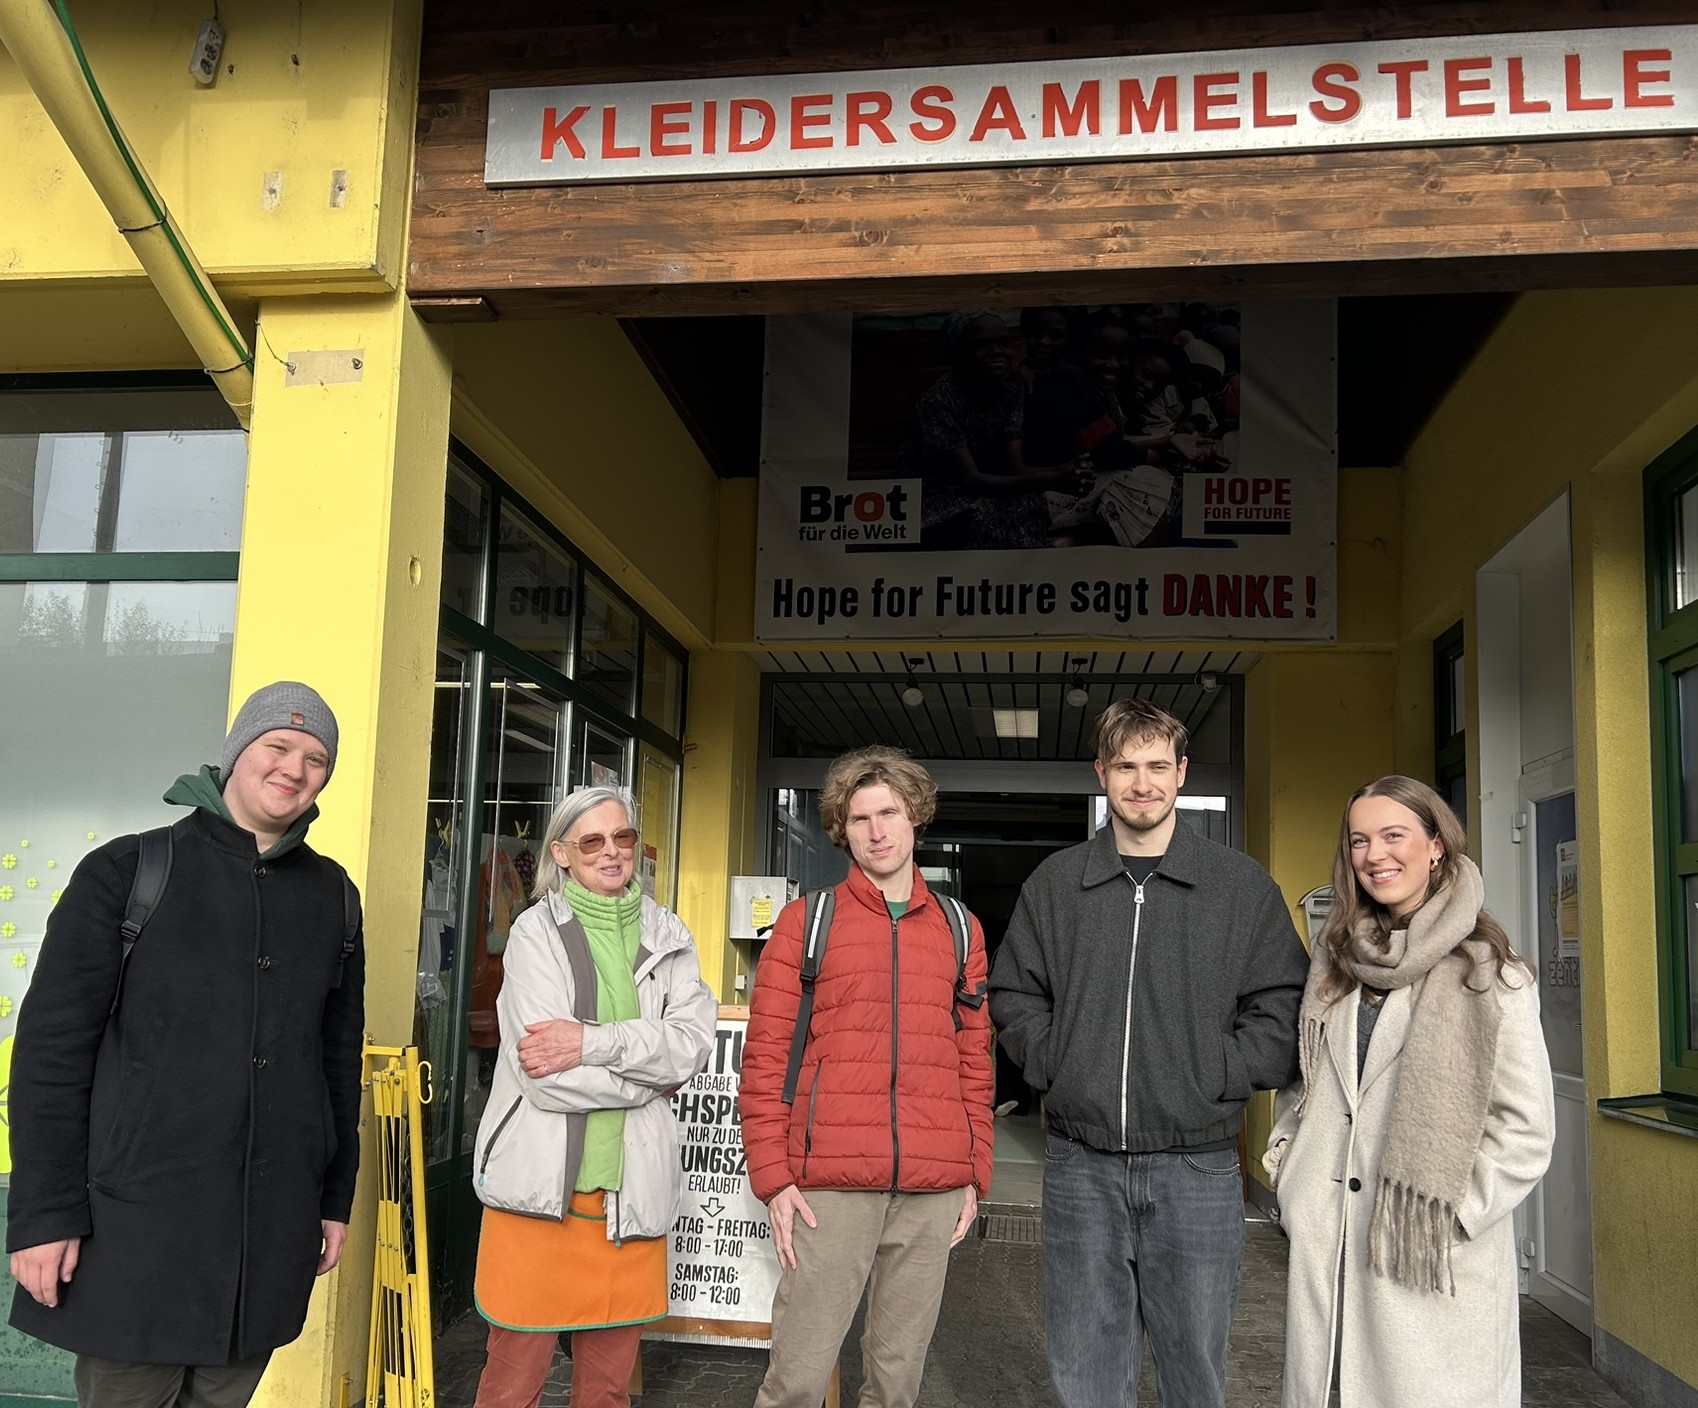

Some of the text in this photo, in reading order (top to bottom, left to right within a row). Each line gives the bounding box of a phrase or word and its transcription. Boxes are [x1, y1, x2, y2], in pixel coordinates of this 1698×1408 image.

[540, 49, 1674, 162] KLEIDERSAMMELSTELLE
[1204, 478, 1291, 505] HOPE
[800, 485, 907, 523] Brot
[1204, 507, 1291, 519] FOR FUTURE
[798, 524, 906, 541] für die Welt
[773, 579, 858, 625] Hope
[871, 578, 923, 617] for
[936, 576, 1056, 616] Future
[1071, 577, 1148, 622] sagt
[1163, 573, 1293, 618] DANKE
[689, 1075, 732, 1092] ABGABE
[687, 1126, 710, 1142] NUR
[712, 1127, 727, 1144] ZU
[679, 1144, 746, 1176] UNGSZ
[688, 1175, 741, 1194] ERLAUBT!
[717, 1219, 770, 1239] FREITAG:
[675, 1236, 701, 1254] 8:00
[713, 1239, 743, 1257] 17:00
[675, 1263, 739, 1283] SAMSTAG:
[670, 1283, 696, 1301] 8:00
[709, 1285, 740, 1305] 12:00
